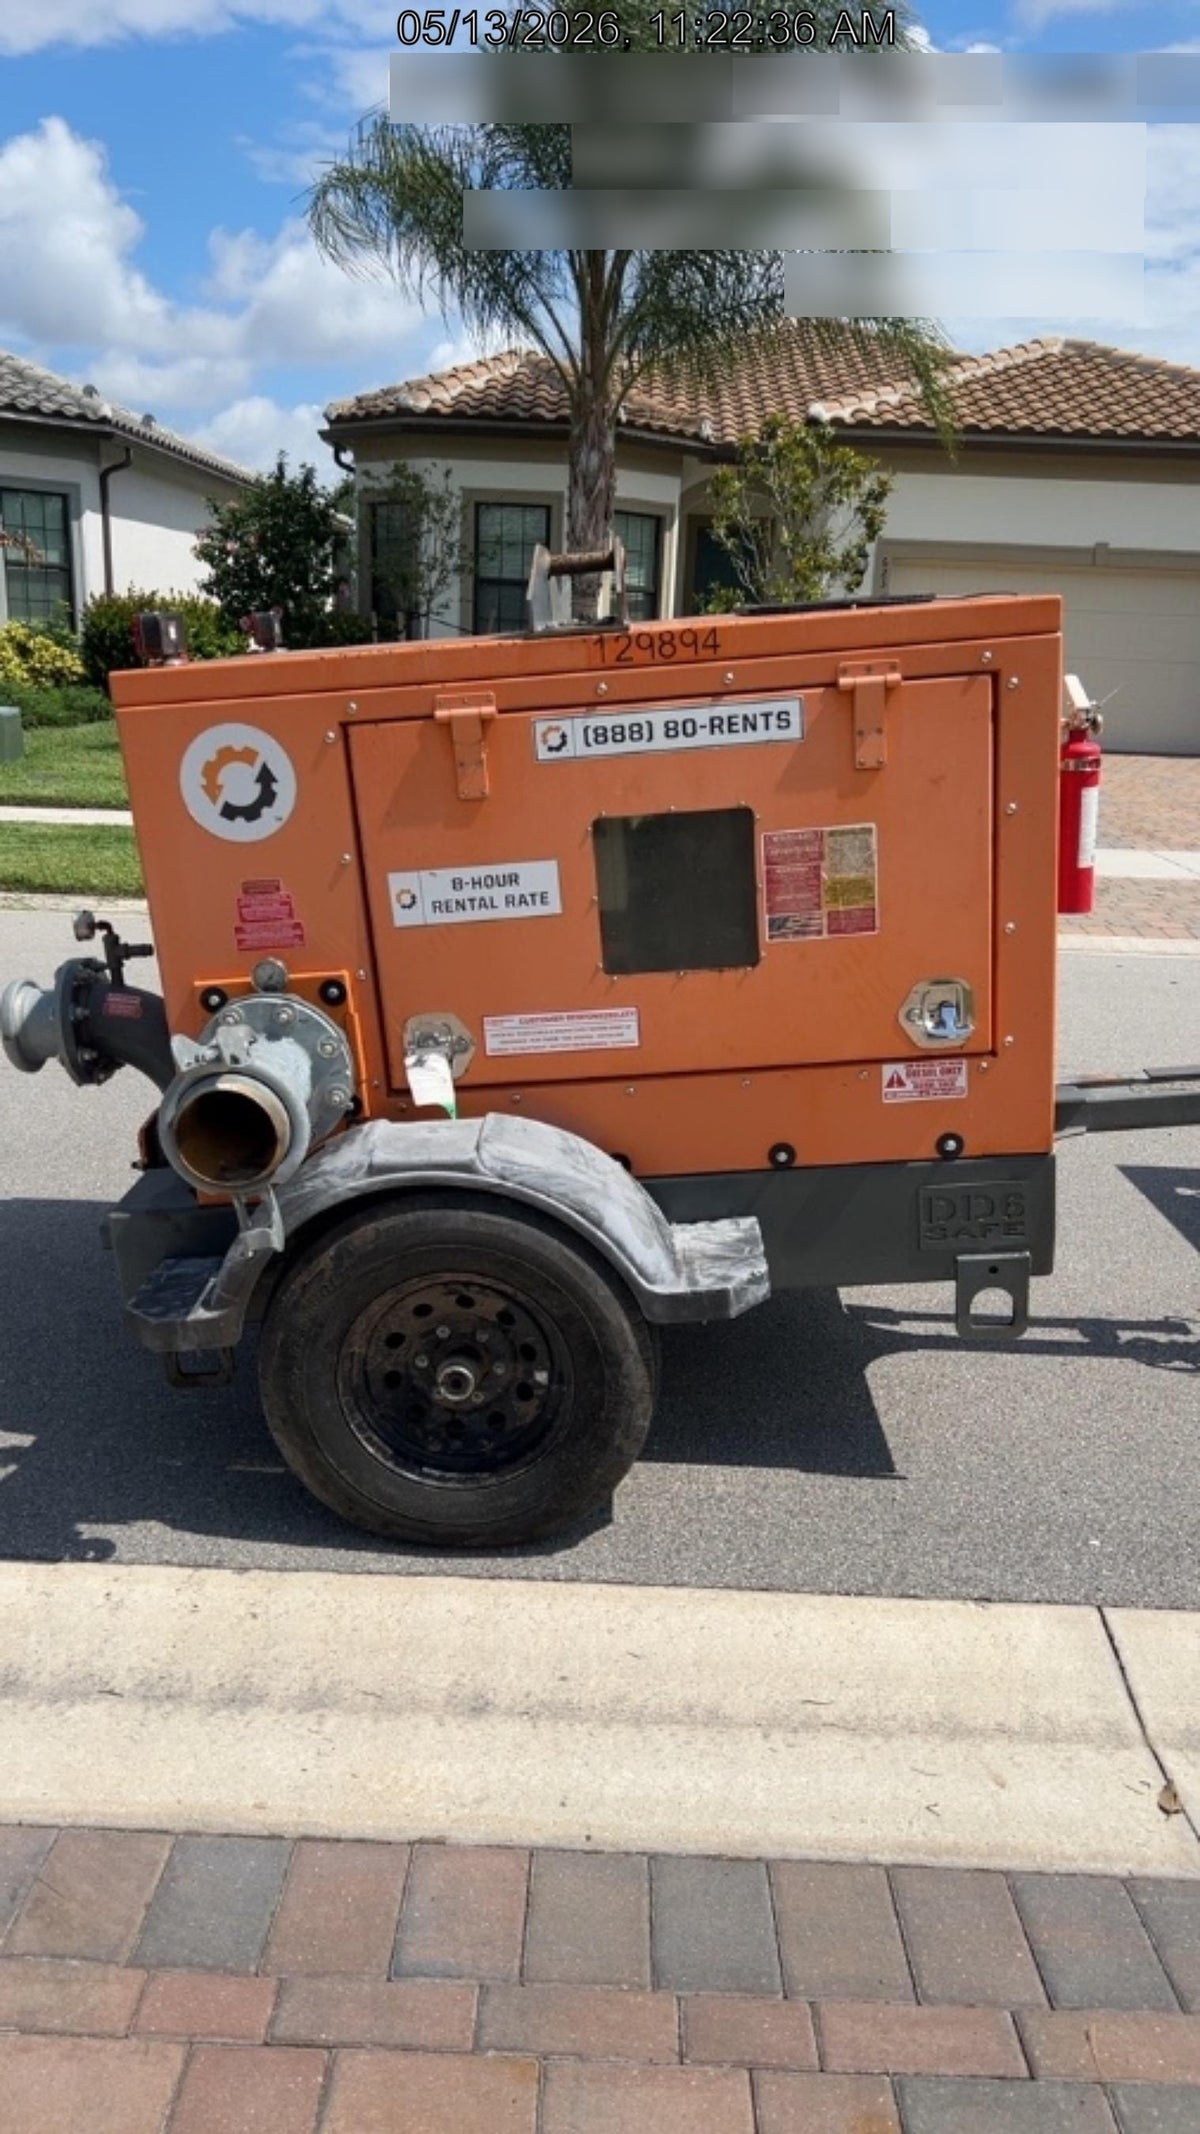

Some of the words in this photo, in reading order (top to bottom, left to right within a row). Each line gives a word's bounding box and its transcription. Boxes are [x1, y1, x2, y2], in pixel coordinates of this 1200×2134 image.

[593, 626, 721, 664] 129894
[583, 720, 654, 748] (888)
[663, 710, 791, 739] 80-RENTS
[452, 872, 521, 892] 8-HOUR
[432, 896, 499, 914] RENTAL
[505, 891, 550, 909] RATE
[924, 1220, 1025, 1241] SAFE
